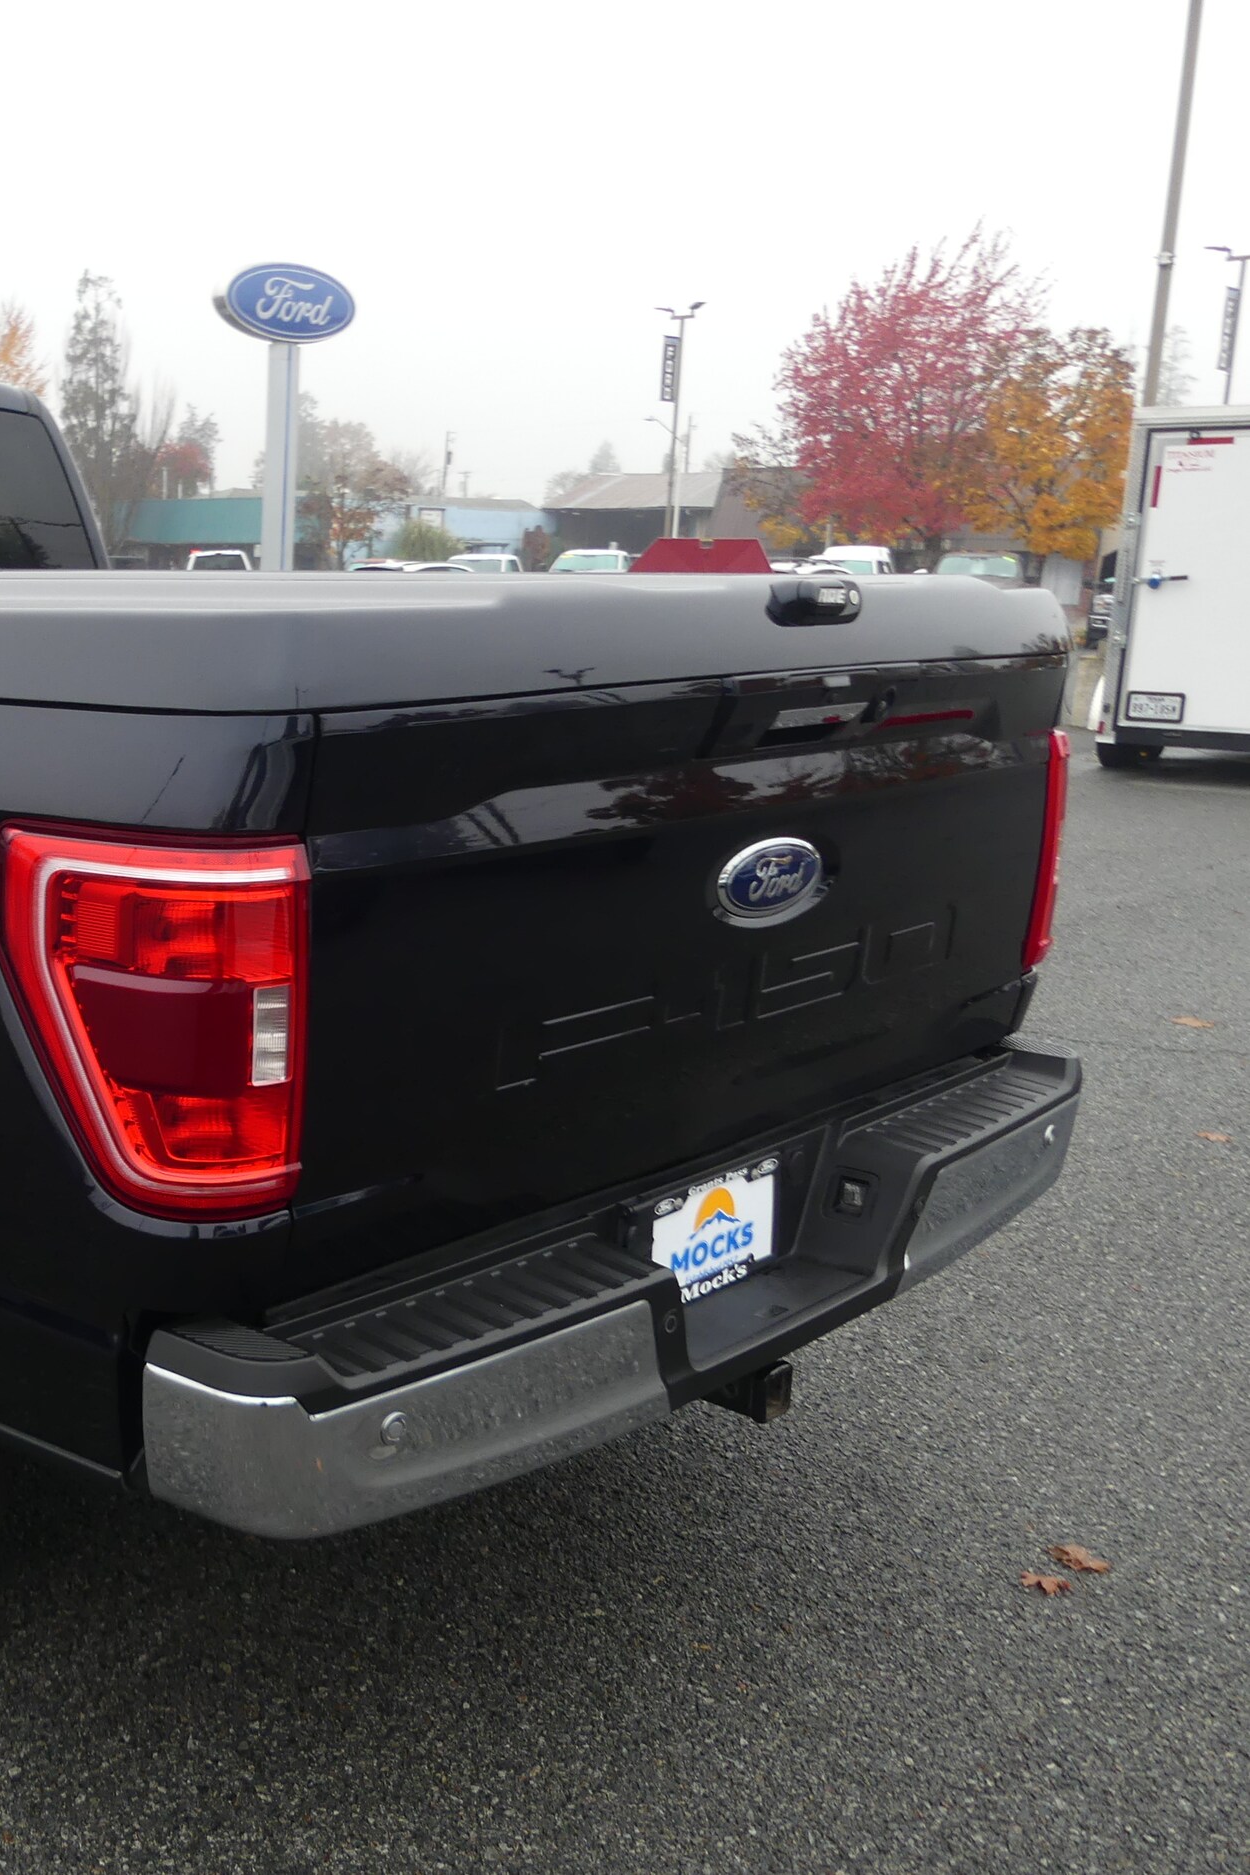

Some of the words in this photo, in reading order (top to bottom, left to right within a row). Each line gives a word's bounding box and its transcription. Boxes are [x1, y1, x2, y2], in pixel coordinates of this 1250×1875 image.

[255, 276, 333, 326] Ford
[748, 855, 805, 902] Ford
[670, 1221, 754, 1272] MOCKS
[680, 1262, 748, 1304] Mock's
